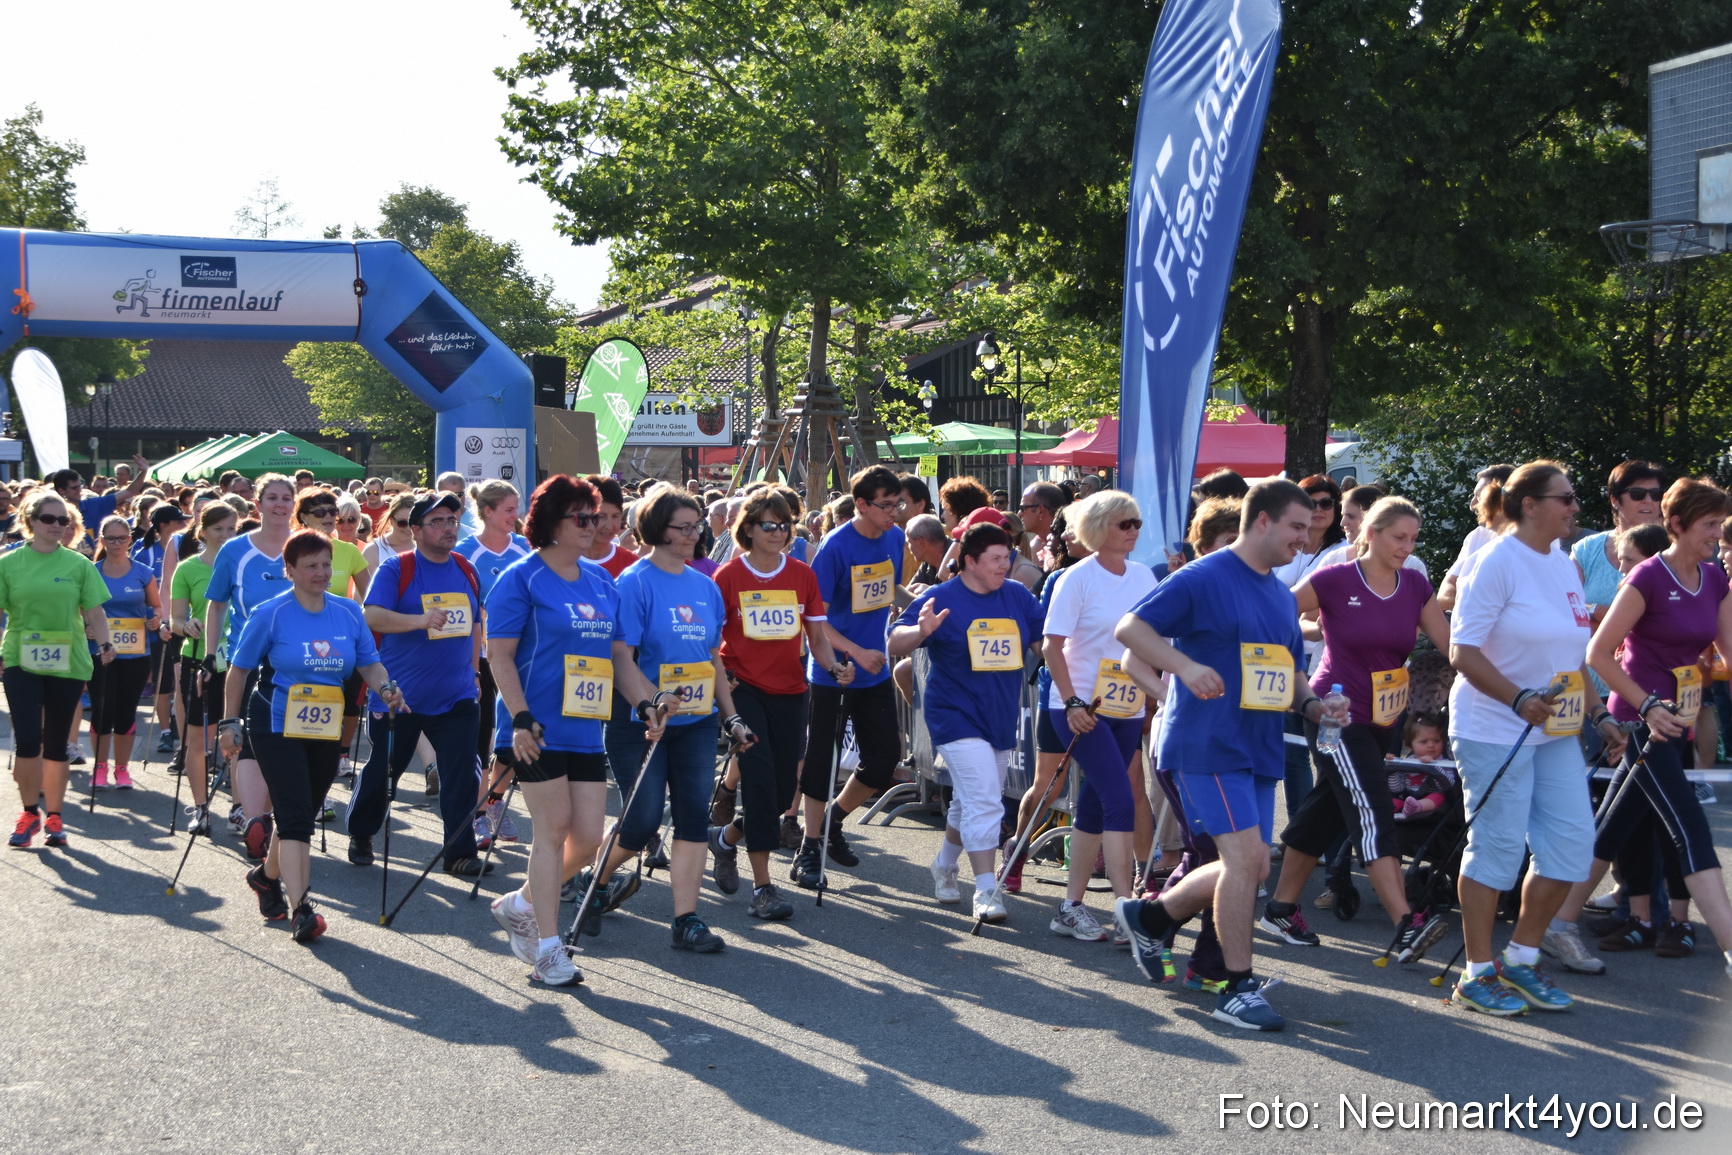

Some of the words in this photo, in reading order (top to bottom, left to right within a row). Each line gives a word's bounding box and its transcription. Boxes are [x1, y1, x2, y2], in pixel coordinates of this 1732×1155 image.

[1153, 0, 1244, 303] Fischer
[1186, 48, 1252, 299] AUTOMOBILE
[193, 268, 234, 277] Fischer
[161, 288, 284, 311] firmenlauf
[160, 311, 212, 319] neumarkt
[407, 334, 425, 344] und
[426, 332, 443, 341] das
[606, 392, 636, 432] AOK
[637, 400, 686, 416] allen
[627, 430, 660, 438] genehmen
[637, 423, 655, 431] grüßt
[862, 579, 888, 599] 795
[447, 609, 467, 625] 32
[564, 603, 579, 619] I
[669, 607, 680, 624] I
[748, 609, 795, 626] 1405
[571, 618, 613, 632] camping
[672, 622, 706, 635] camping
[113, 632, 138, 644] 566
[30, 647, 62, 662] 134
[302, 642, 312, 657] I
[979, 639, 1011, 657] 745
[303, 656, 344, 668] camping
[1254, 669, 1287, 693] 773
[575, 680, 604, 702] 481
[682, 683, 704, 703] 94
[1104, 682, 1138, 703] 215
[1378, 687, 1408, 712] 1111
[296, 705, 332, 724] 493
[1556, 697, 1581, 718] 214
